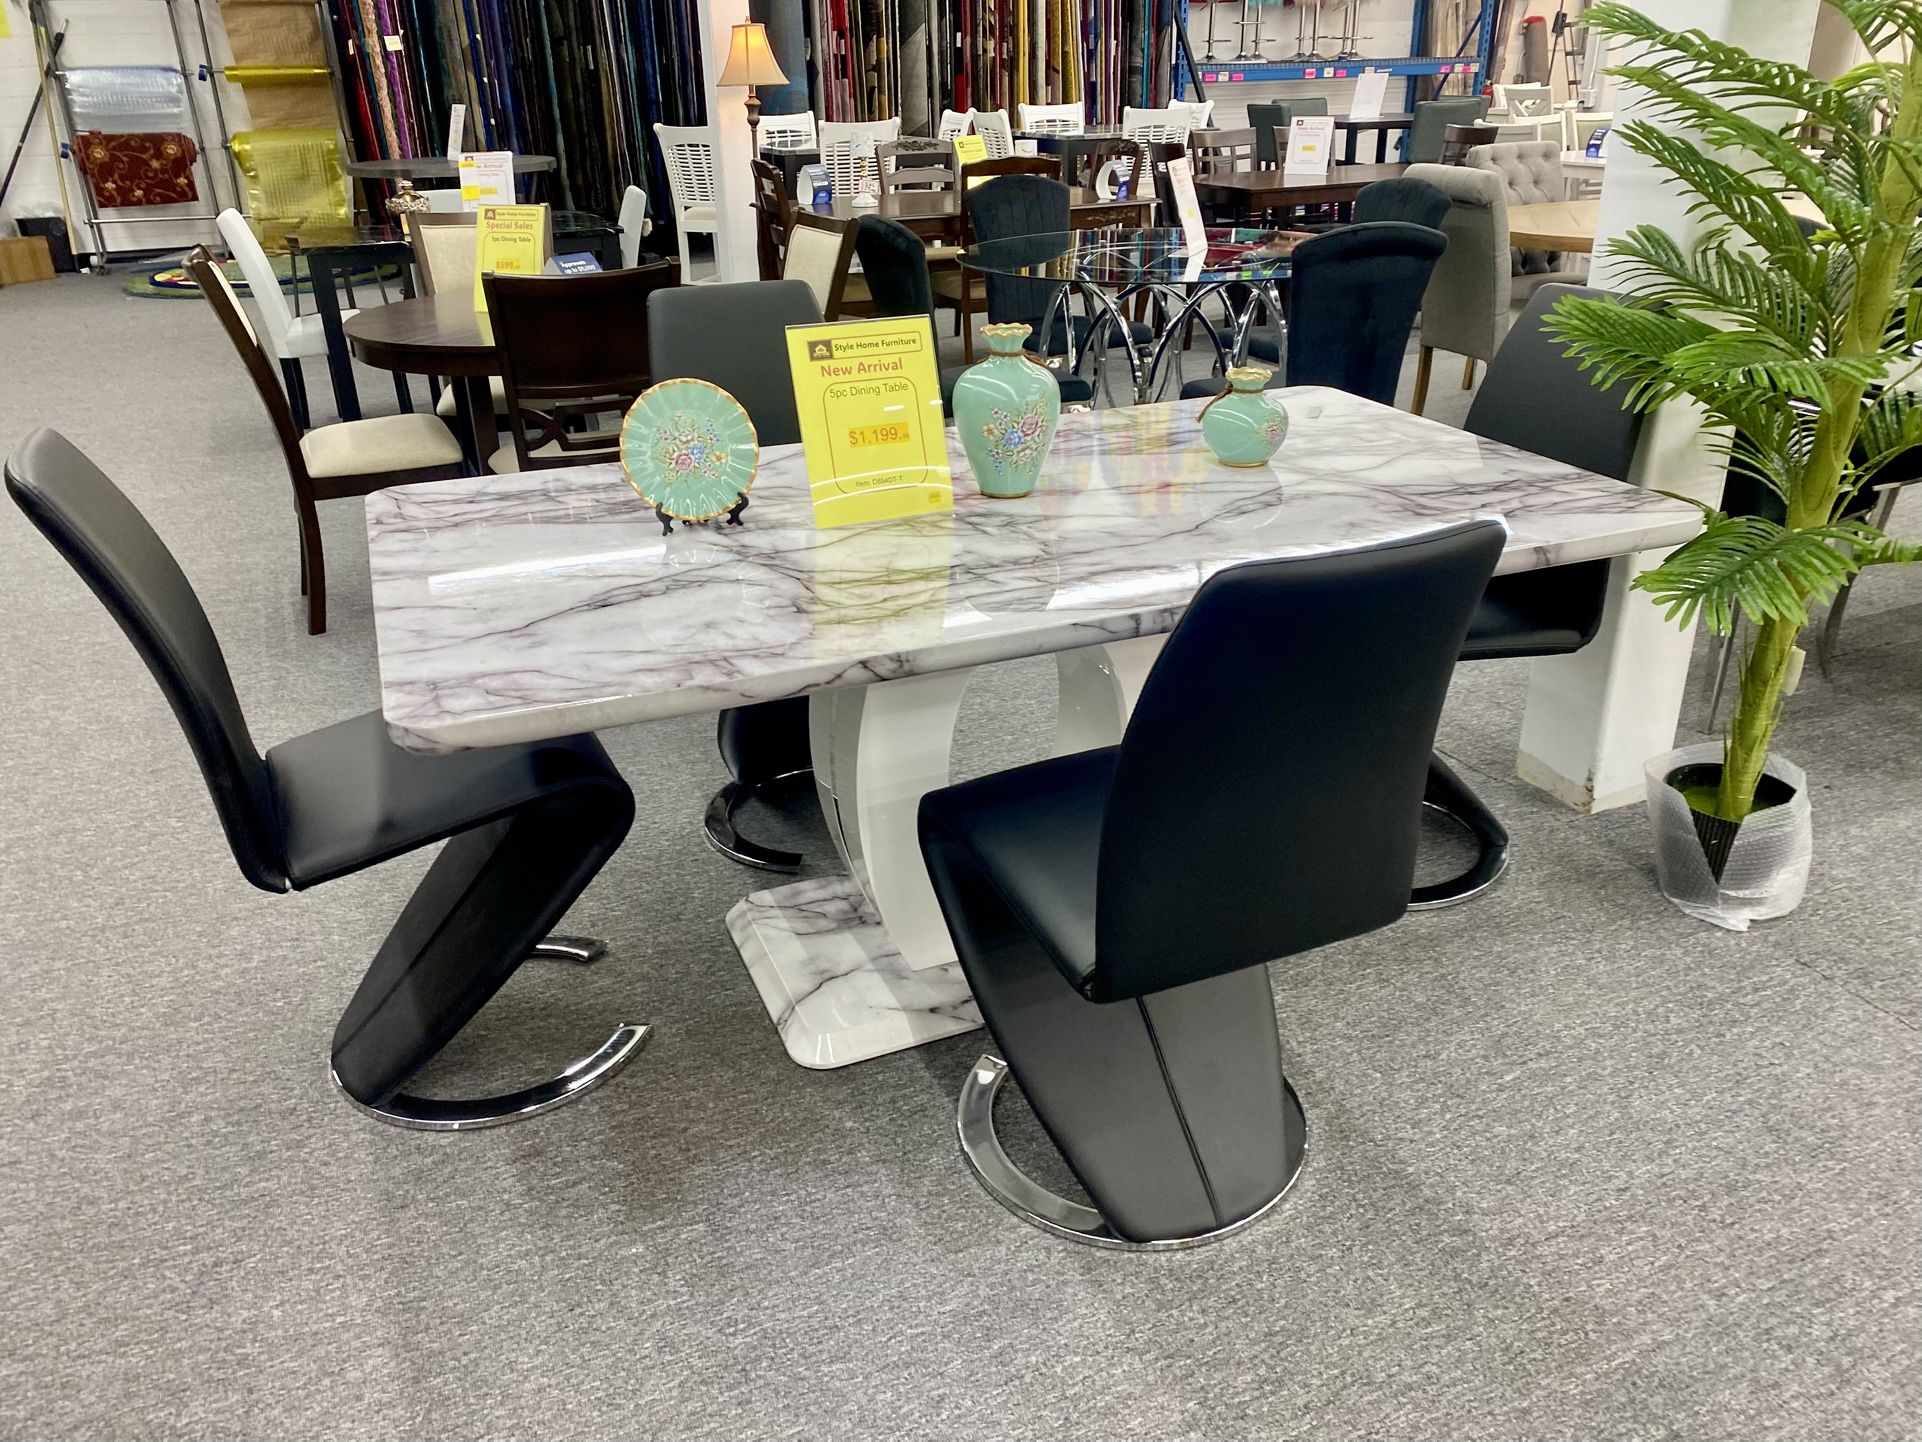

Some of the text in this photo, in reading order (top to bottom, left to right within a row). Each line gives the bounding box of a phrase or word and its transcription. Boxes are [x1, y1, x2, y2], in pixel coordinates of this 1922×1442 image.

[486, 221, 533, 231] Special Sales
[501, 236, 518, 244] Dining
[834, 337, 917, 353] Style Home Furniture
[820, 357, 904, 378] New Arrival
[829, 381, 909, 400] 5pc Dining Table
